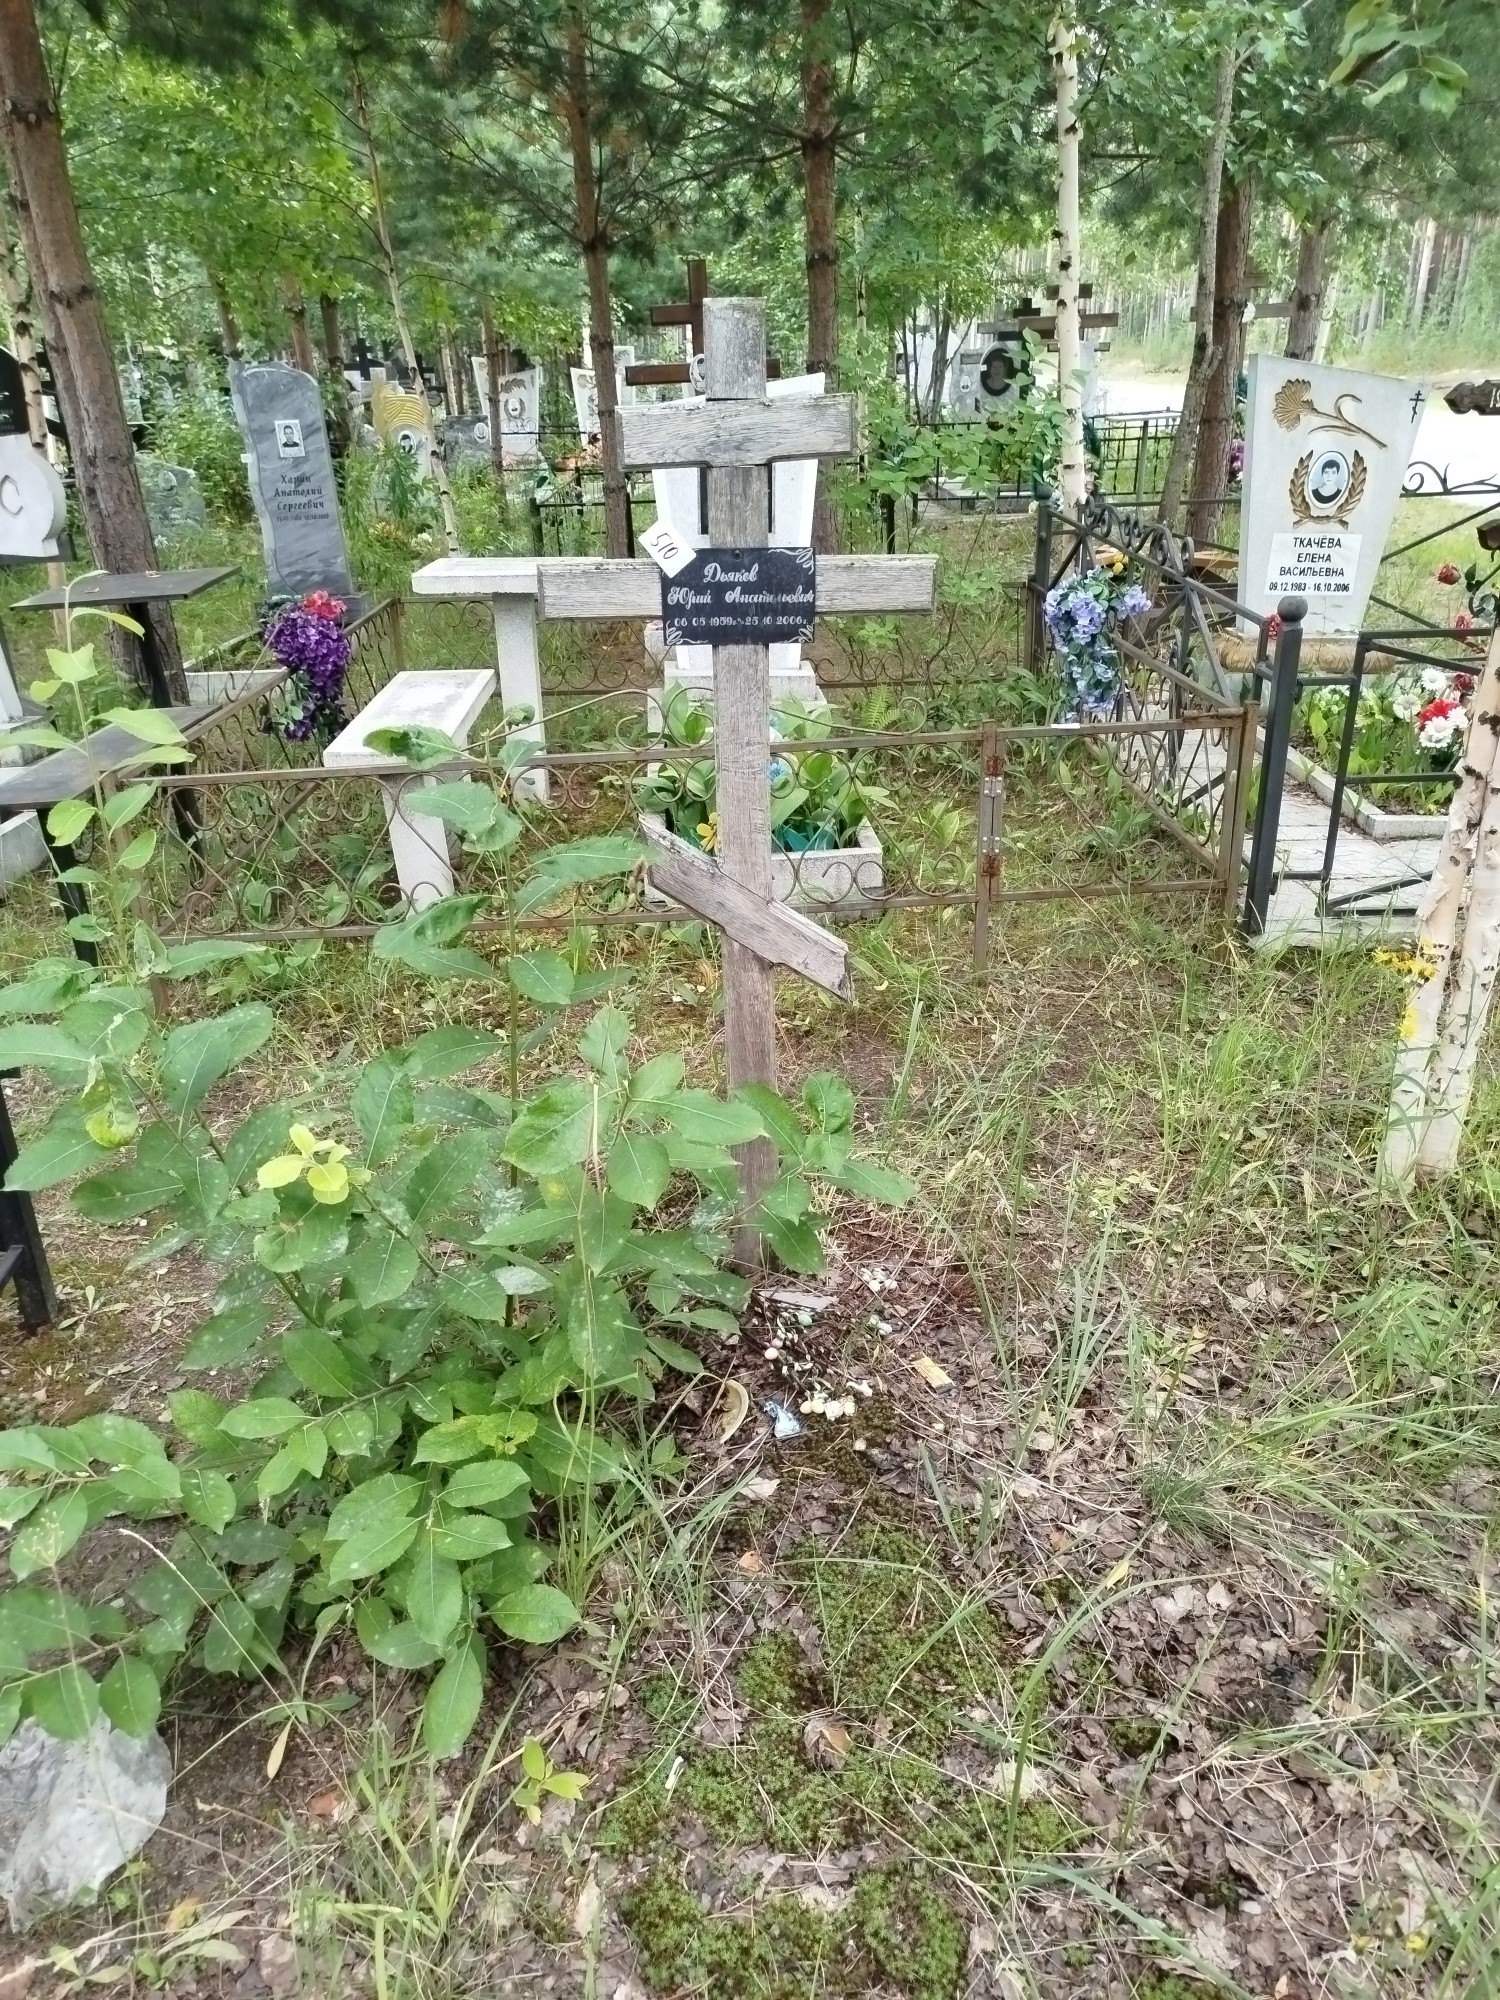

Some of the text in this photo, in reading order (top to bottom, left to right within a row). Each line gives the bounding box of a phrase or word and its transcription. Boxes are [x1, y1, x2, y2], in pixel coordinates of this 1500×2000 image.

[274, 486, 322, 498] Анатолий
[277, 499, 324, 512] Сергеевич
[651, 532, 679, 560] 510
[1293, 535, 1342, 549] ТКАЧЁВА
[1297, 553, 1332, 563] ЕЛЕНА
[703, 562, 759, 584] Дьяков
[1279, 566, 1345, 577] ВАСИЛЬЕВНА
[1269, 582, 1307, 592] 09.12.1983
[1313, 582, 1351, 593] 16.10.2006
[667, 586, 712, 610] Юрий
